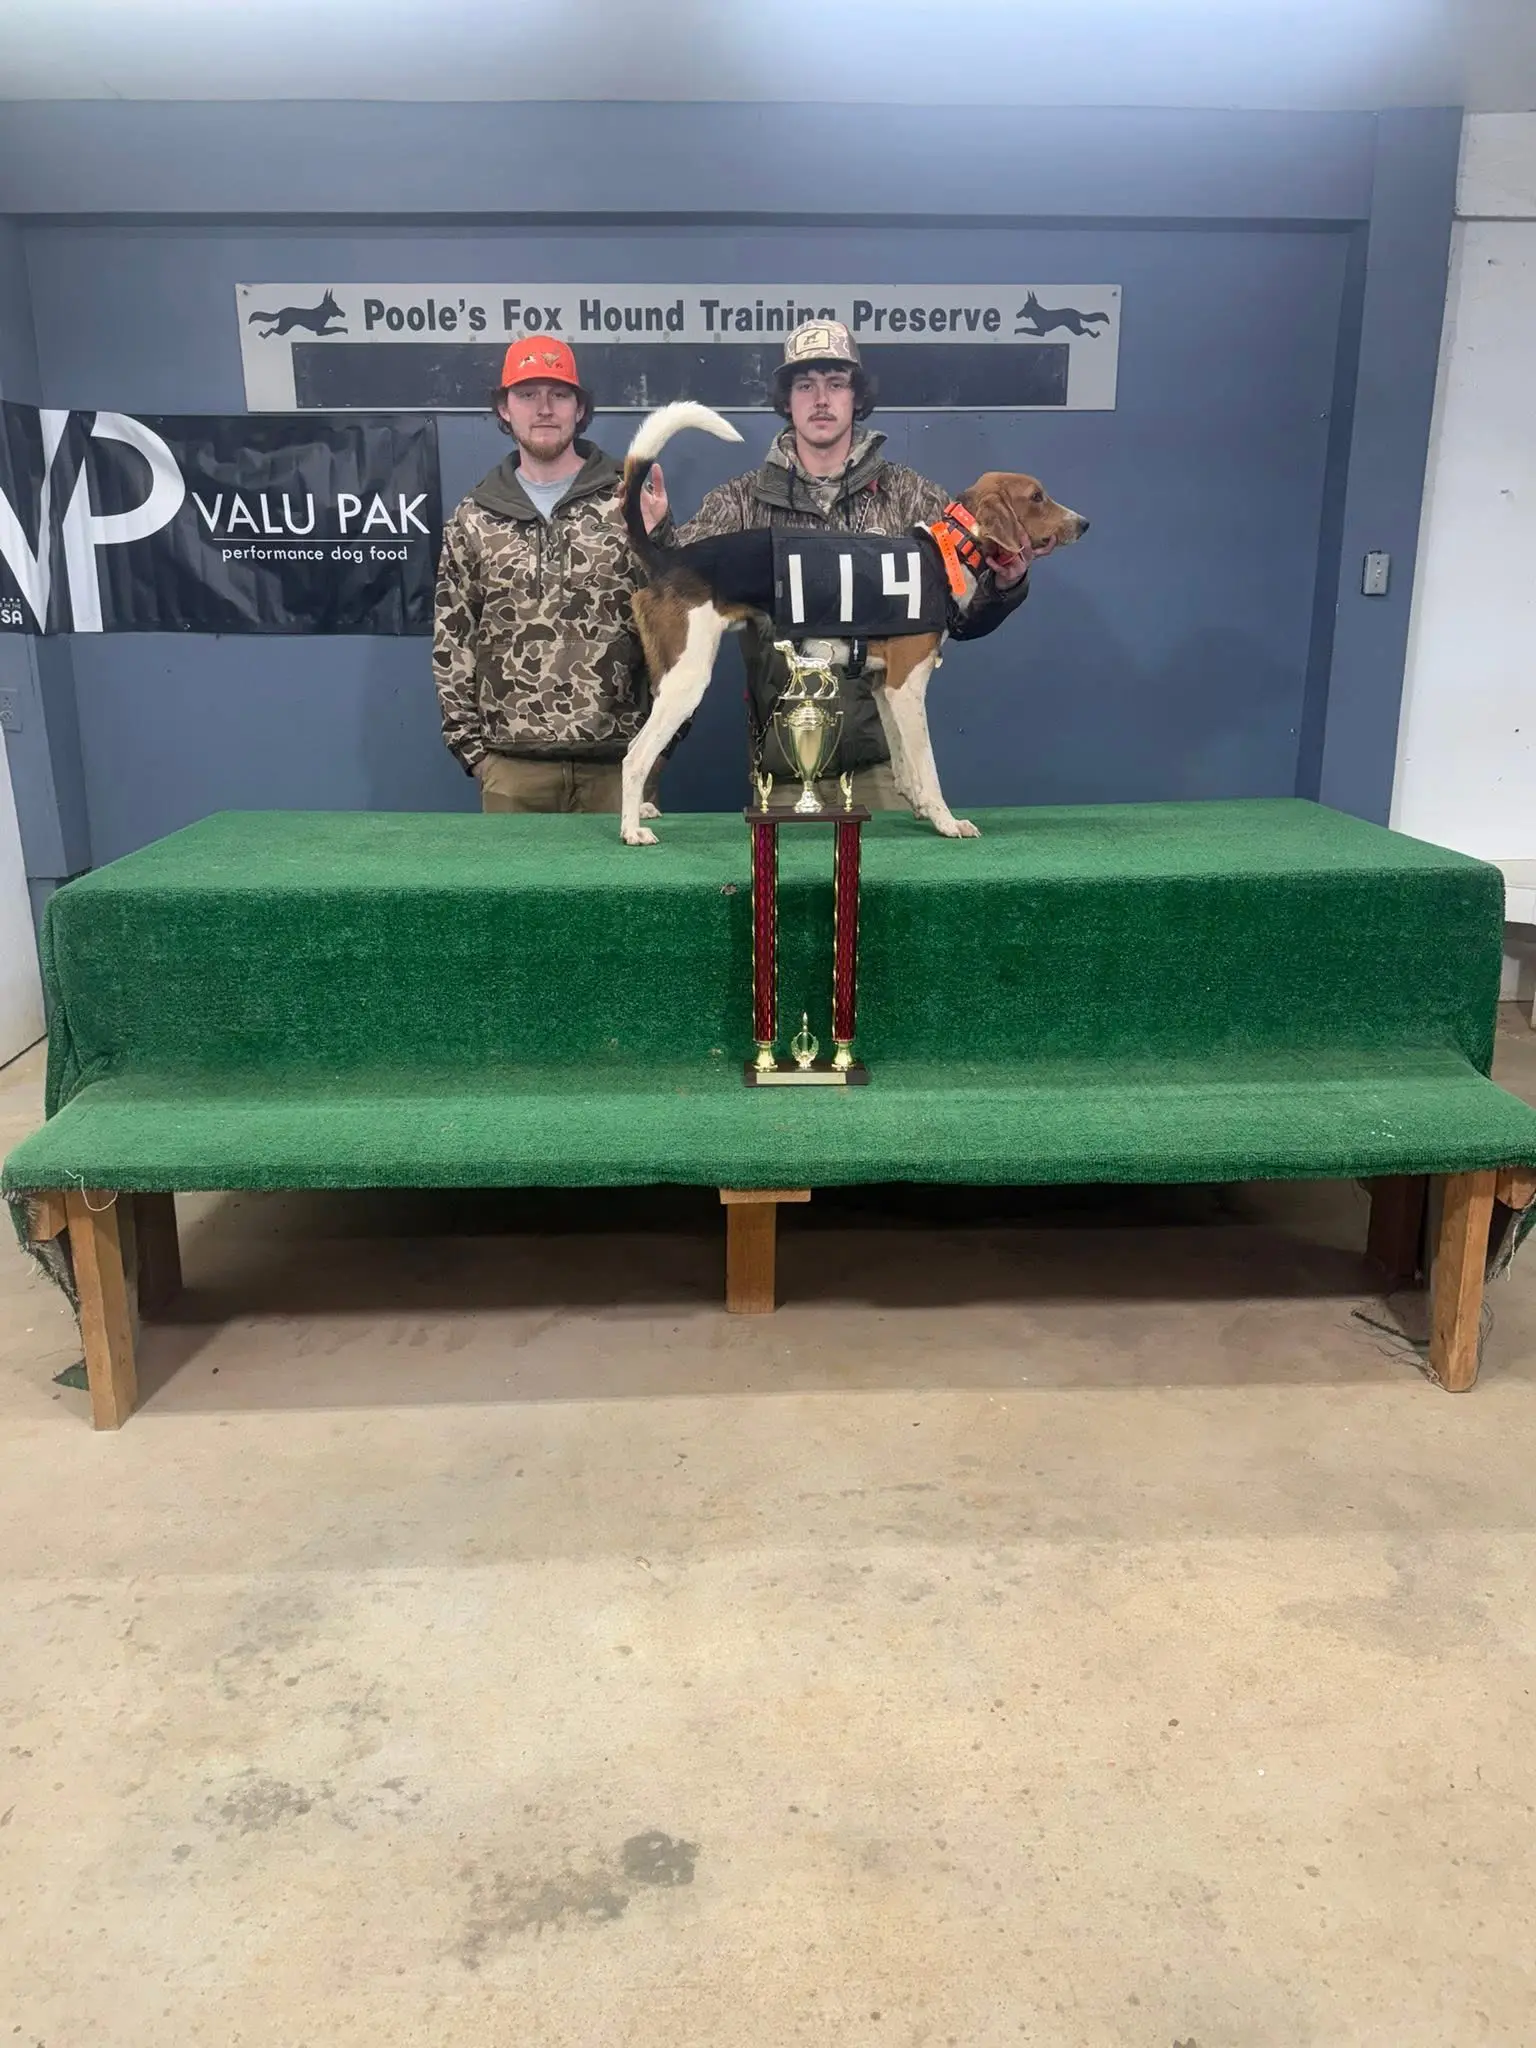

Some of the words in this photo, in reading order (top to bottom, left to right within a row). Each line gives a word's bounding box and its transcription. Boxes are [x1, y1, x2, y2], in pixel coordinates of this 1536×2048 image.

[364, 299, 486, 331] Poole's
[504, 299, 562, 331] Fox
[580, 299, 684, 331] Hound
[853, 300, 1000, 332] Preserve
[191, 492, 316, 535] VALU
[337, 492, 431, 534] PAK
[222, 546, 324, 562] performance
[331, 547, 363, 563] dog
[370, 547, 408, 560] food
[788, 552, 922, 623] 114
